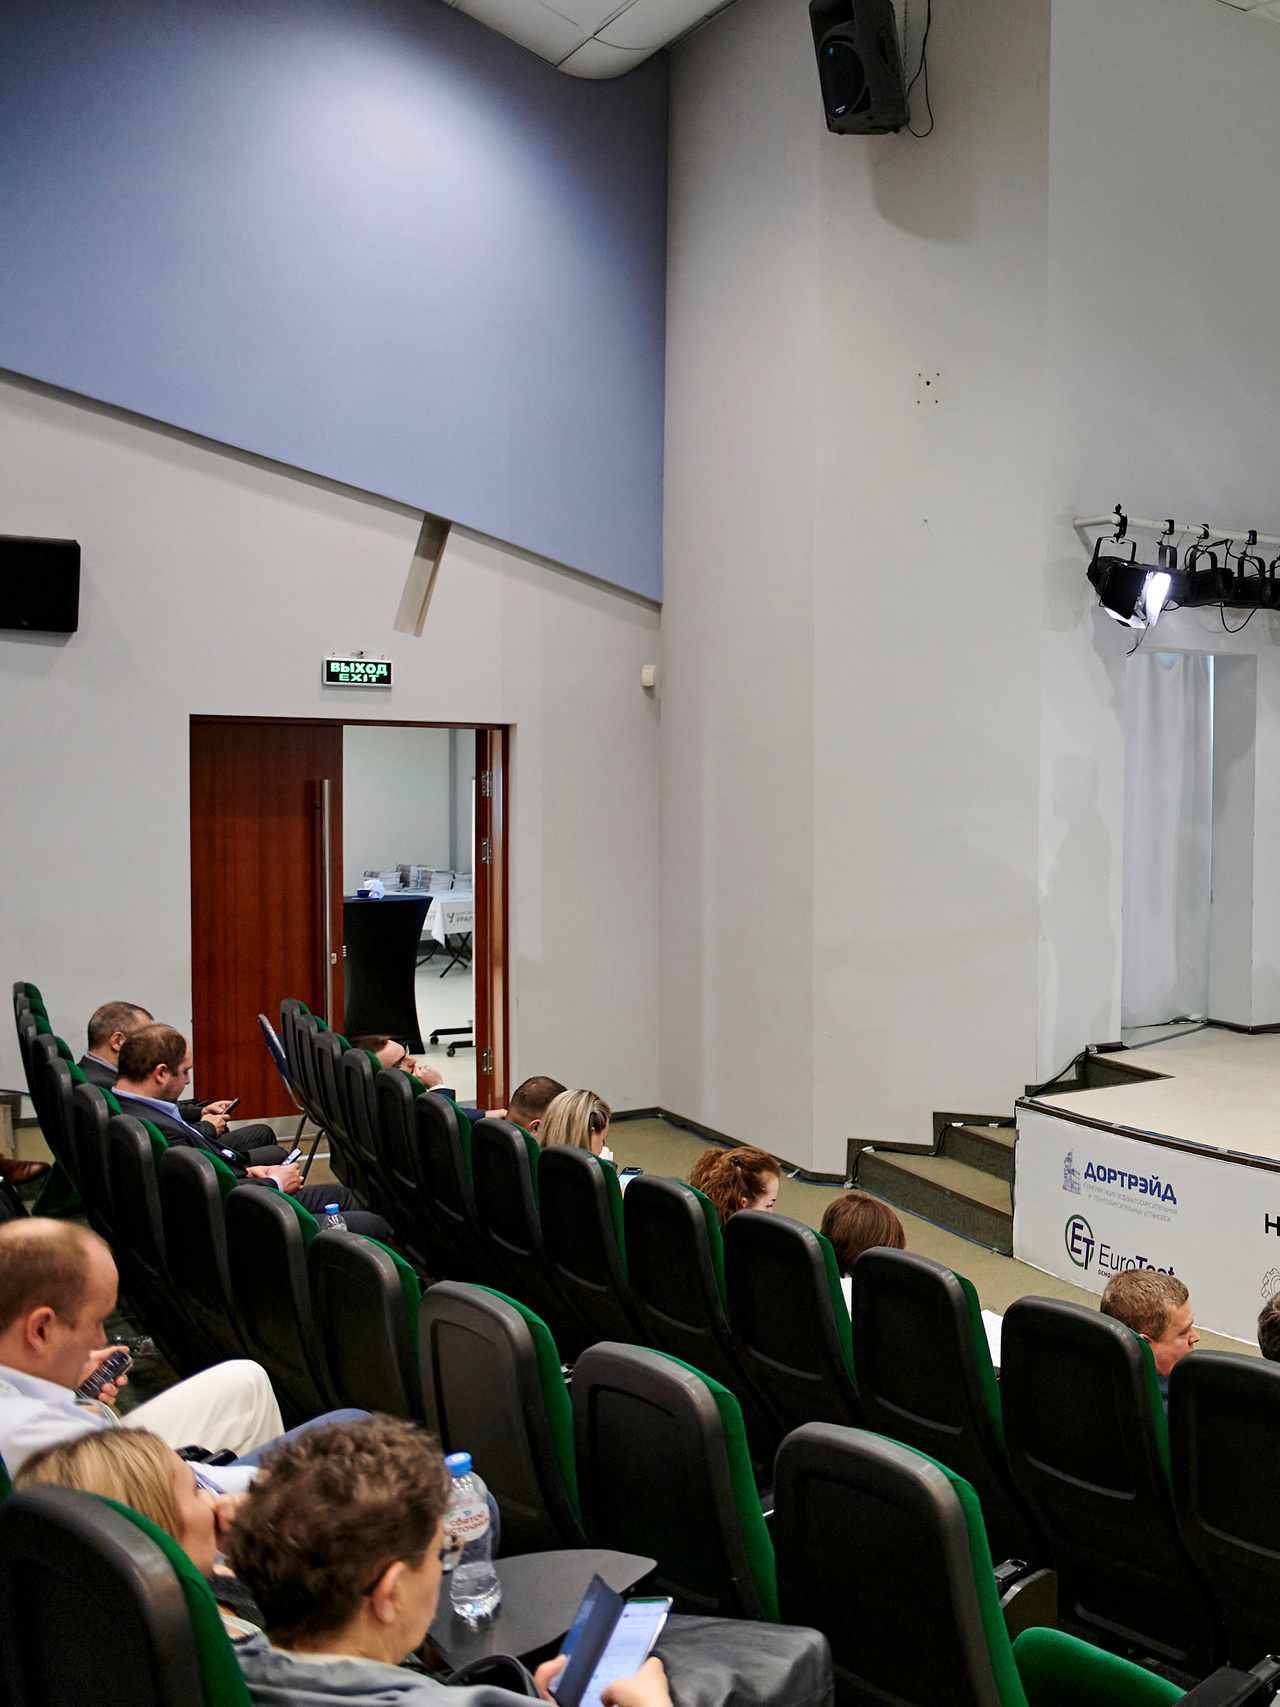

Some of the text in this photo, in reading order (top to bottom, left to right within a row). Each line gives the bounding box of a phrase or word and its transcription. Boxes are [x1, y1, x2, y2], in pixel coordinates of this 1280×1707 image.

[330, 662, 387, 676] ВЫХОД
[339, 674, 379, 682] EXIT
[1084, 1162, 1177, 1205] ДОРТРЭЙД
